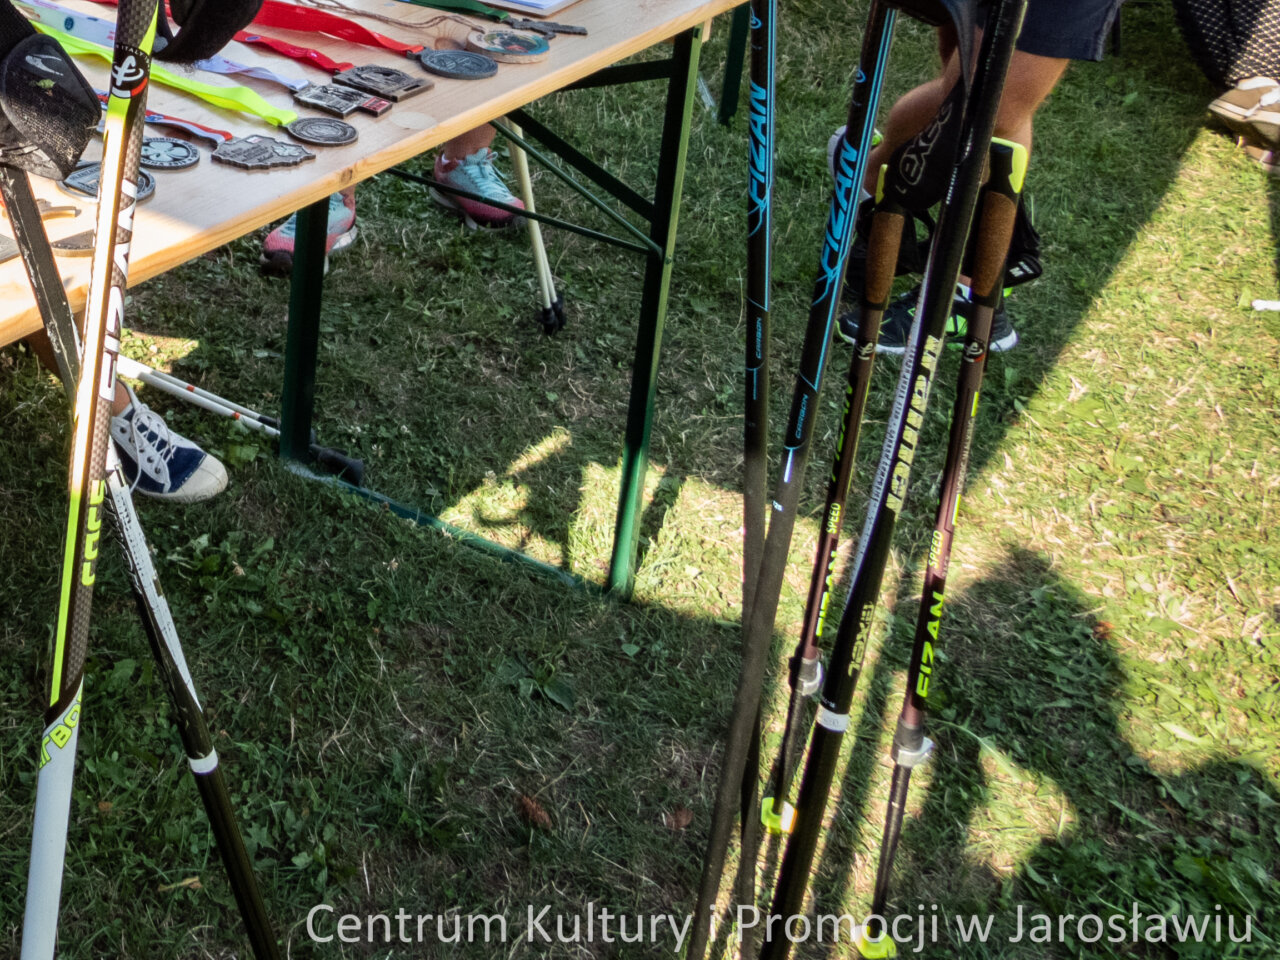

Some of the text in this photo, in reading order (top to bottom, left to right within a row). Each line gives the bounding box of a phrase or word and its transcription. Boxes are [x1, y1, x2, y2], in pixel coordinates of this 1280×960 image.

[749, 80, 767, 206] FIZAN
[821, 139, 858, 276] FIZAN
[826, 503, 841, 534] SPEED
[928, 530, 944, 568] SPEED
[916, 591, 944, 697] FIZAN
